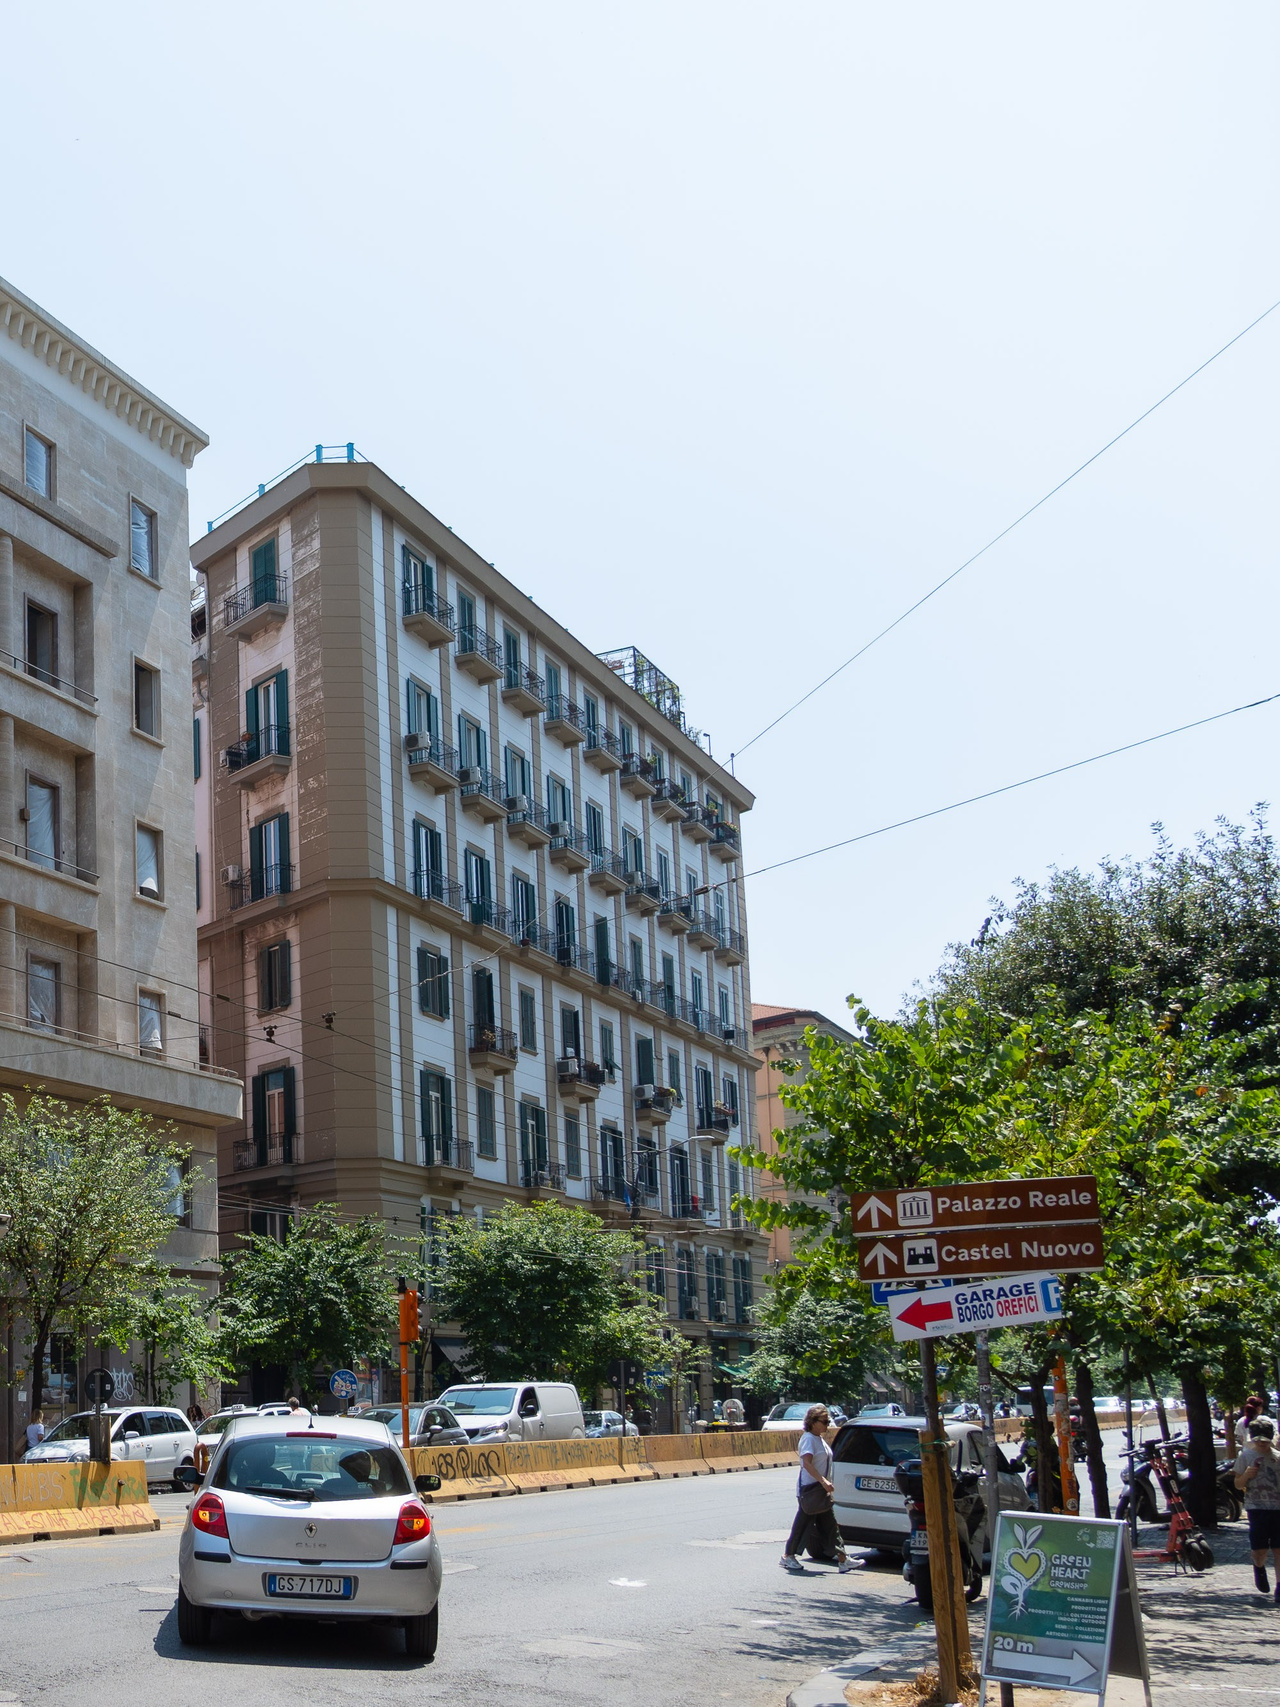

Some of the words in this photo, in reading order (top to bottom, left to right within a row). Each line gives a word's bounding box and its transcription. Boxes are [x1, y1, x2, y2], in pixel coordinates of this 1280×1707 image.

[937, 1196, 1021, 1213] Palazzo
[1029, 1189, 1092, 1208] Reale
[941, 1243, 1011, 1262] Castel
[1021, 1241, 1095, 1258] Nuovo
[955, 1282, 1036, 1305] GARAGE
[957, 1302, 994, 1323] BORGO
[996, 1295, 1039, 1317] OREFICI
[1051, 1554, 1091, 1568] GREEN
[1051, 1566, 1090, 1580] HEART
[277, 1577, 295, 1592] GS
[298, 1578, 342, 1594] 717DJ
[994, 1636, 1014, 1650] 20
[1016, 1642, 1034, 1653] m
